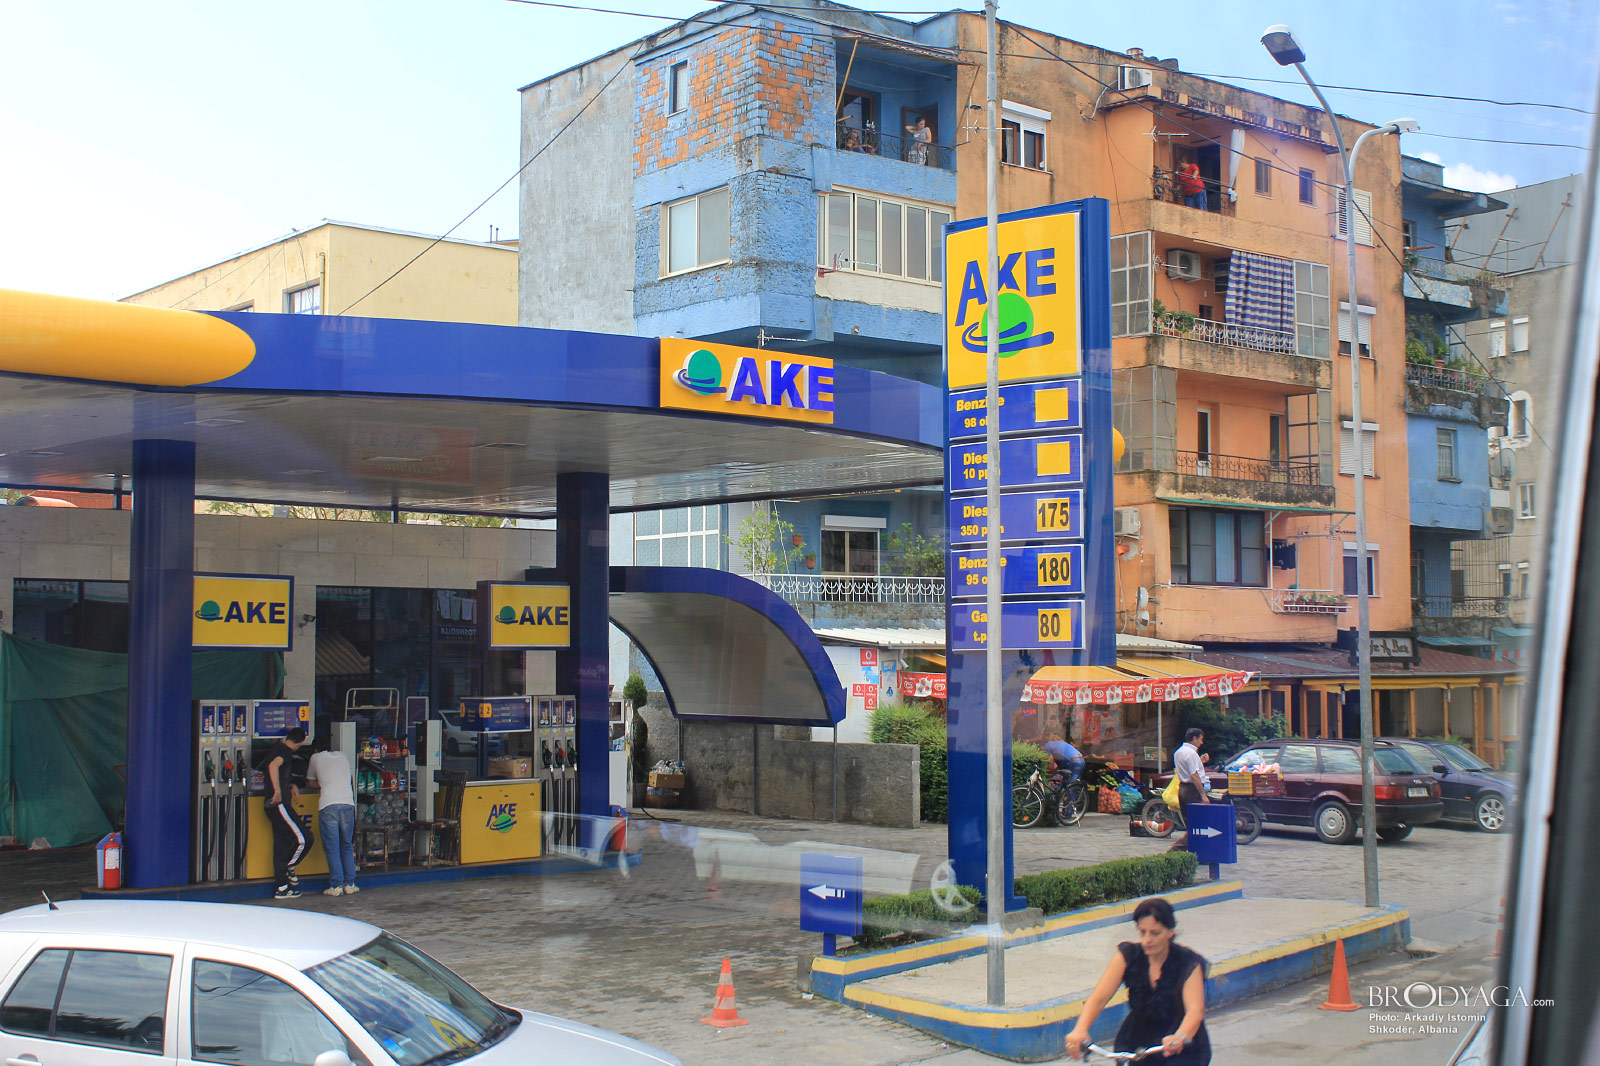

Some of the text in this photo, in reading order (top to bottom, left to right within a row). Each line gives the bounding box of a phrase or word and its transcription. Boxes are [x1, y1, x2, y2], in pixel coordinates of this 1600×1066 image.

[955, 248, 1056, 326] AKE
[725, 357, 835, 411] AKE
[956, 396, 1005, 412] Benzie
[964, 417, 977, 428] 98
[963, 450, 1000, 466] Dies
[963, 468, 976, 480] 10
[963, 502, 1069, 529] Dies 175
[960, 524, 979, 536] 350
[959, 556, 1070, 582] Benze 180
[966, 573, 979, 586] 95
[224, 601, 286, 624] AKE
[518, 606, 569, 626] AKE
[1040, 613, 1060, 637] 80
[300, 709, 306, 718] 3
[485, 803, 517, 827] AKE
